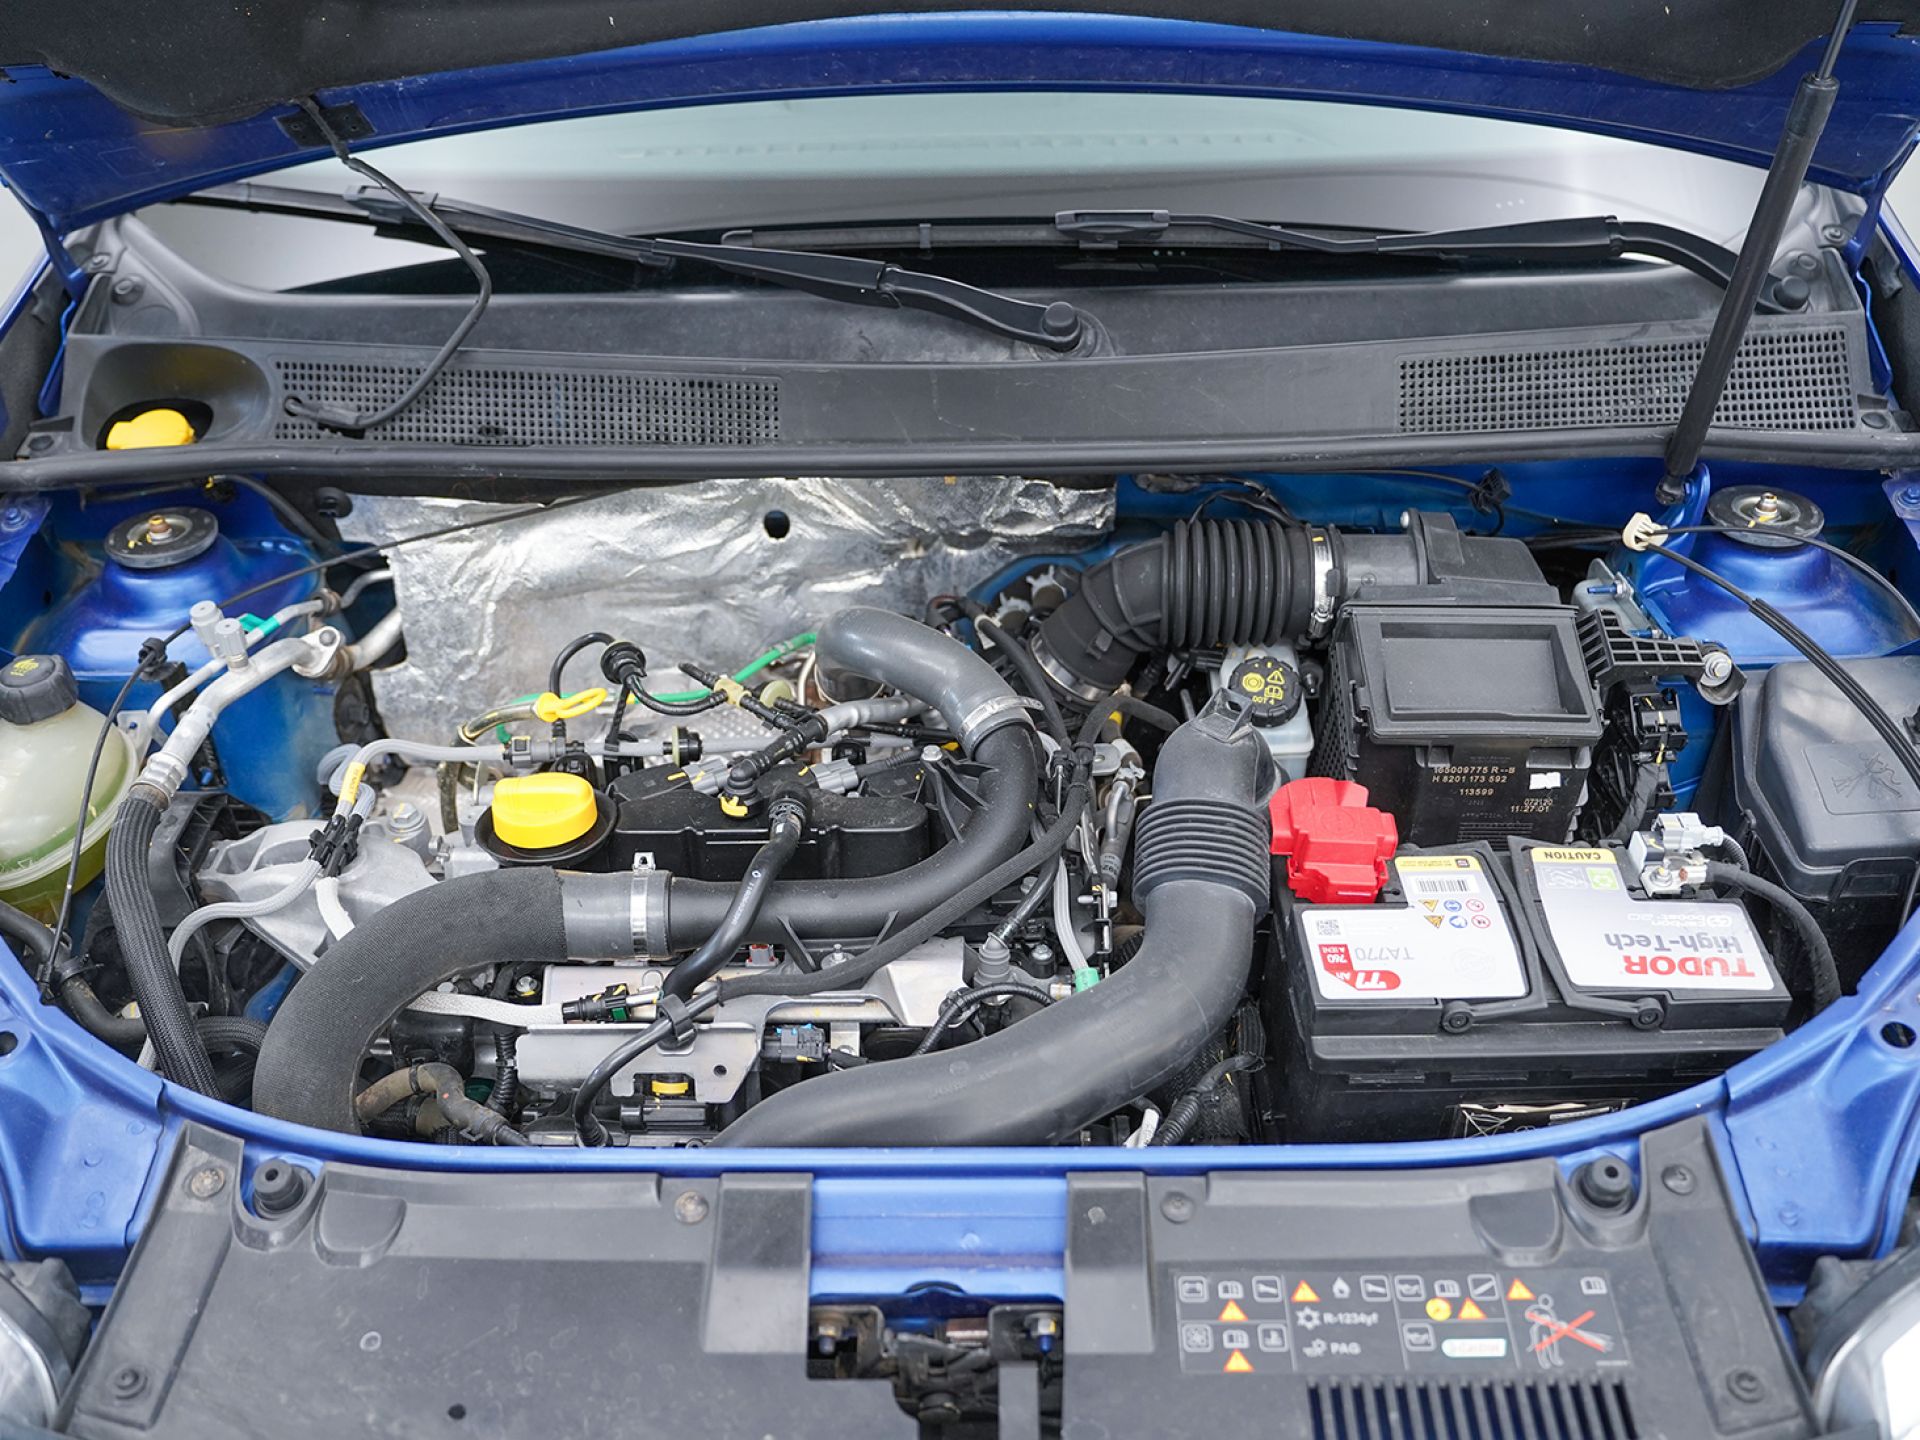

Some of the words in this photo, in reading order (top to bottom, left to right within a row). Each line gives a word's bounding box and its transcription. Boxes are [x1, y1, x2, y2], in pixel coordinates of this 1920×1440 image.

[1252, 695, 1267, 704] DOT
[1432, 775, 1440, 783] H
[1442, 775, 1466, 783] 8201
[1469, 775, 1486, 783] 173
[1488, 775, 1508, 783] 592
[1459, 788, 1495, 796] 113599
[1543, 851, 1602, 861] CAUTION
[1605, 932, 1743, 953] High-Tech
[1326, 953, 1348, 964] 760
[1354, 946, 1415, 961] TA770
[1622, 955, 1755, 977] TUDOR
[1355, 971, 1387, 989] 77
[1323, 1311, 1379, 1327] R-1234yf
[1329, 1341, 1362, 1355] PAG
